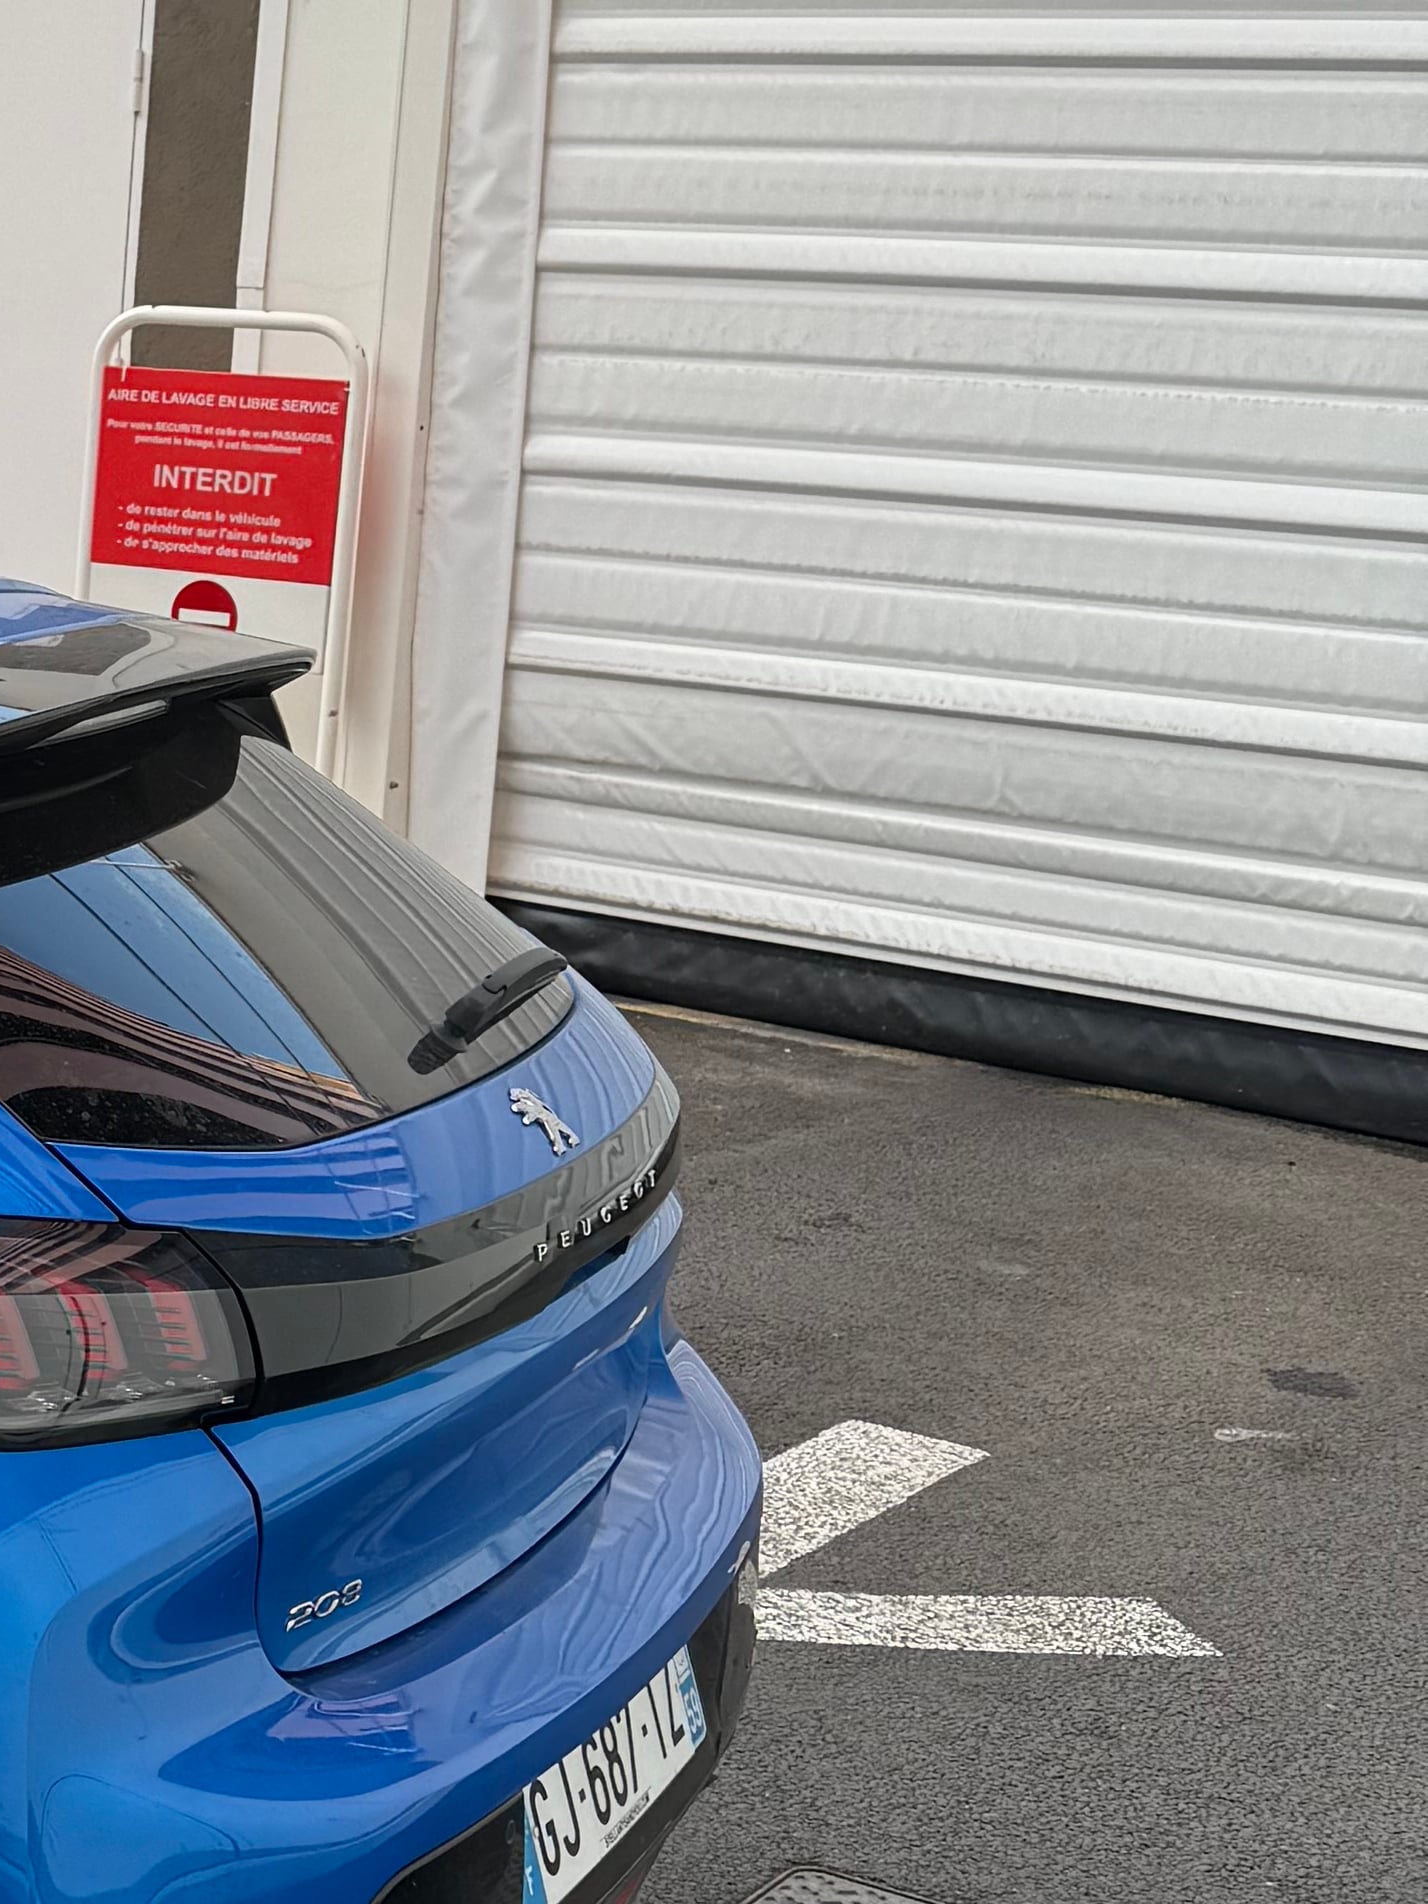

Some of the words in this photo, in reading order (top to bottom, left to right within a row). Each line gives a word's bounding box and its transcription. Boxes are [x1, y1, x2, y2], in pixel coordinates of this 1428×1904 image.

[108, 388, 138, 402] AIRE
[142, 390, 160, 404] DE
[162, 392, 214, 407] LAVAGE
[218, 395, 236, 409] EN
[240, 396, 279, 412] LIBRE
[281, 399, 339, 415] SERVICE
[153, 463, 278, 497] INTERDIT
[126, 503, 142, 515] de
[144, 506, 179, 518] rester
[182, 507, 212, 521] dans
[215, 510, 226, 522] le
[125, 519, 140, 531] de
[196, 528, 217, 539] sur
[252, 531, 267, 543] de
[271, 533, 312, 550] lavage
[215, 545, 239, 558] des
[537, 1169, 657, 1262] PEUGEOT
[286, 1578, 362, 1632] 208
[684, 1689, 704, 1735] 59
